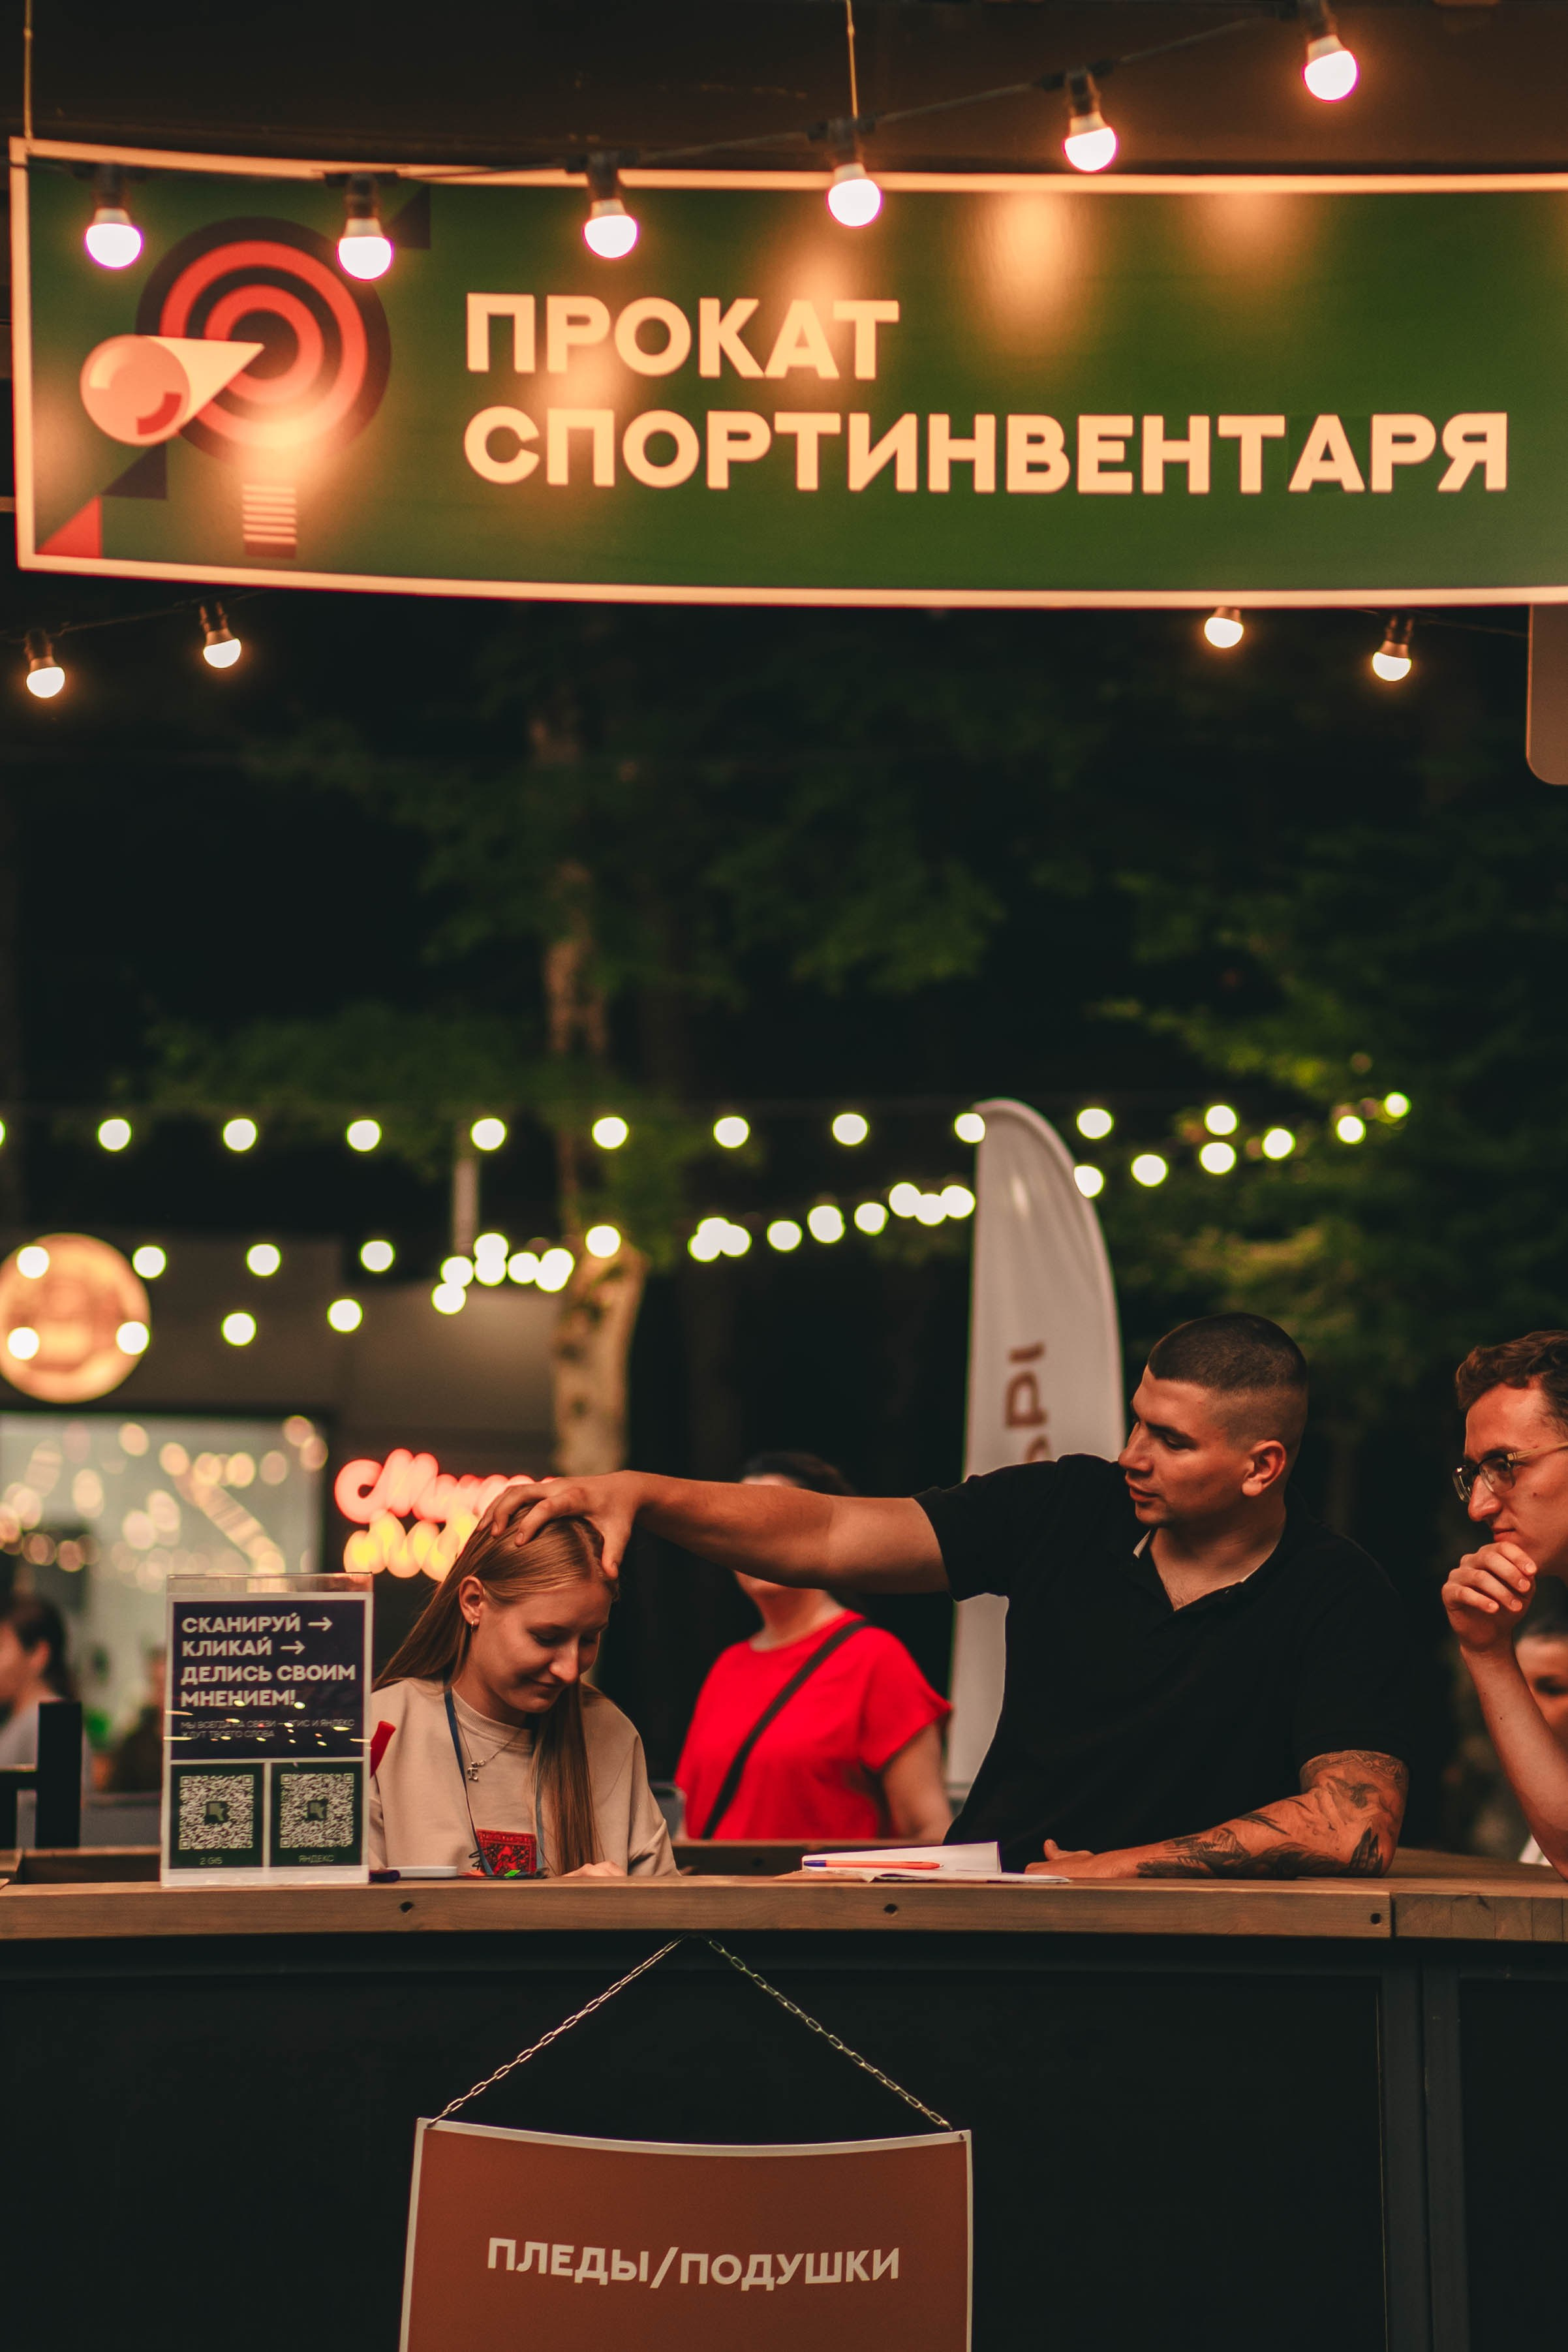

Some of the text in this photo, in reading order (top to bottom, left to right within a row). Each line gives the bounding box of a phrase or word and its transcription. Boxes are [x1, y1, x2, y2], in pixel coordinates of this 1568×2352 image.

[465, 291, 900, 381] ПРОКАТ
[463, 405, 1509, 494] СПОРТИНВЕНТАРЯ
[181, 1612, 301, 1633] СКАНИРУЙ
[181, 1636, 272, 1656] КЛИКАЙ
[180, 1665, 356, 1685] ДЕЛИСЬ СВОИМ
[180, 1689, 296, 1707] МНЕНИЕМ!
[486, 2236, 901, 2292] ПЛЕДЫ/ПОДУШКИ
